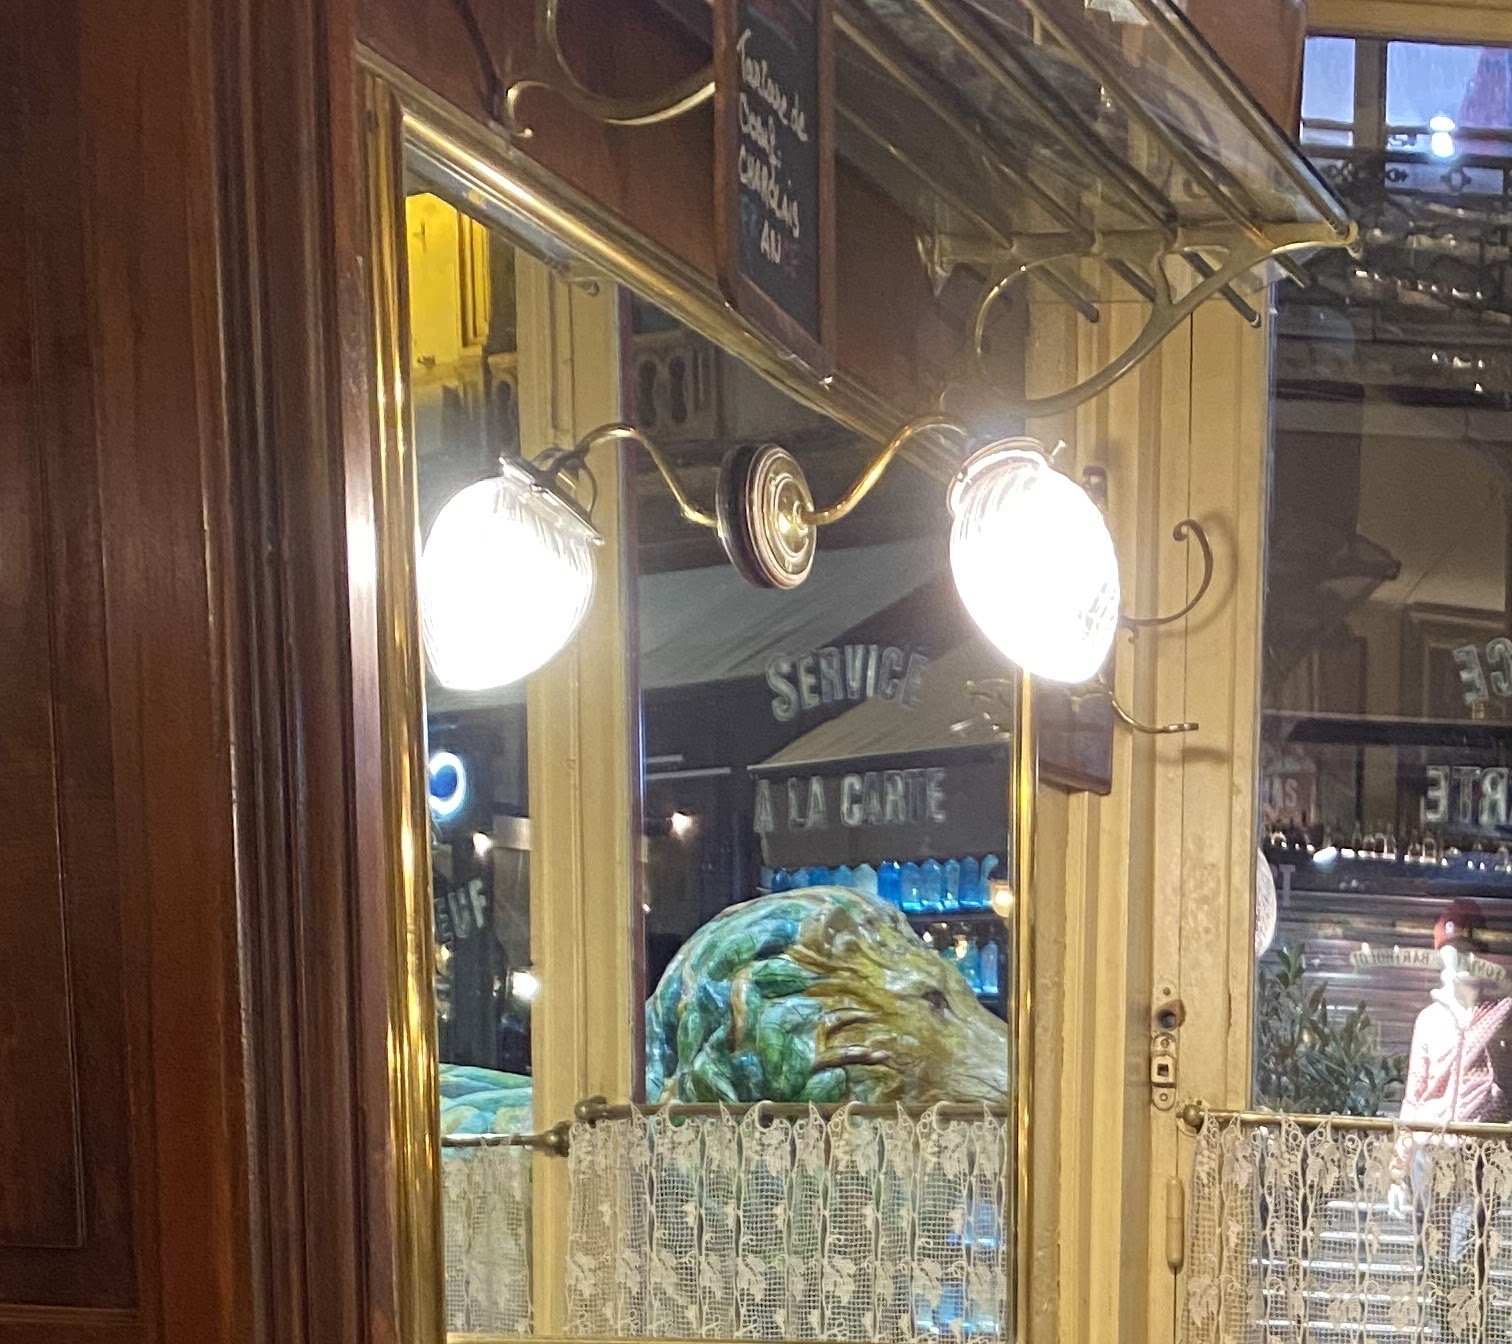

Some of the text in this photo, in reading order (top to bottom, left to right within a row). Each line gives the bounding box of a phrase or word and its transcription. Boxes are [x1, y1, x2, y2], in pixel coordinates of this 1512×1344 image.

[765, 644, 929, 722] SERVICE
[787, 775, 828, 833] LA
[840, 767, 947, 827] CARTE
